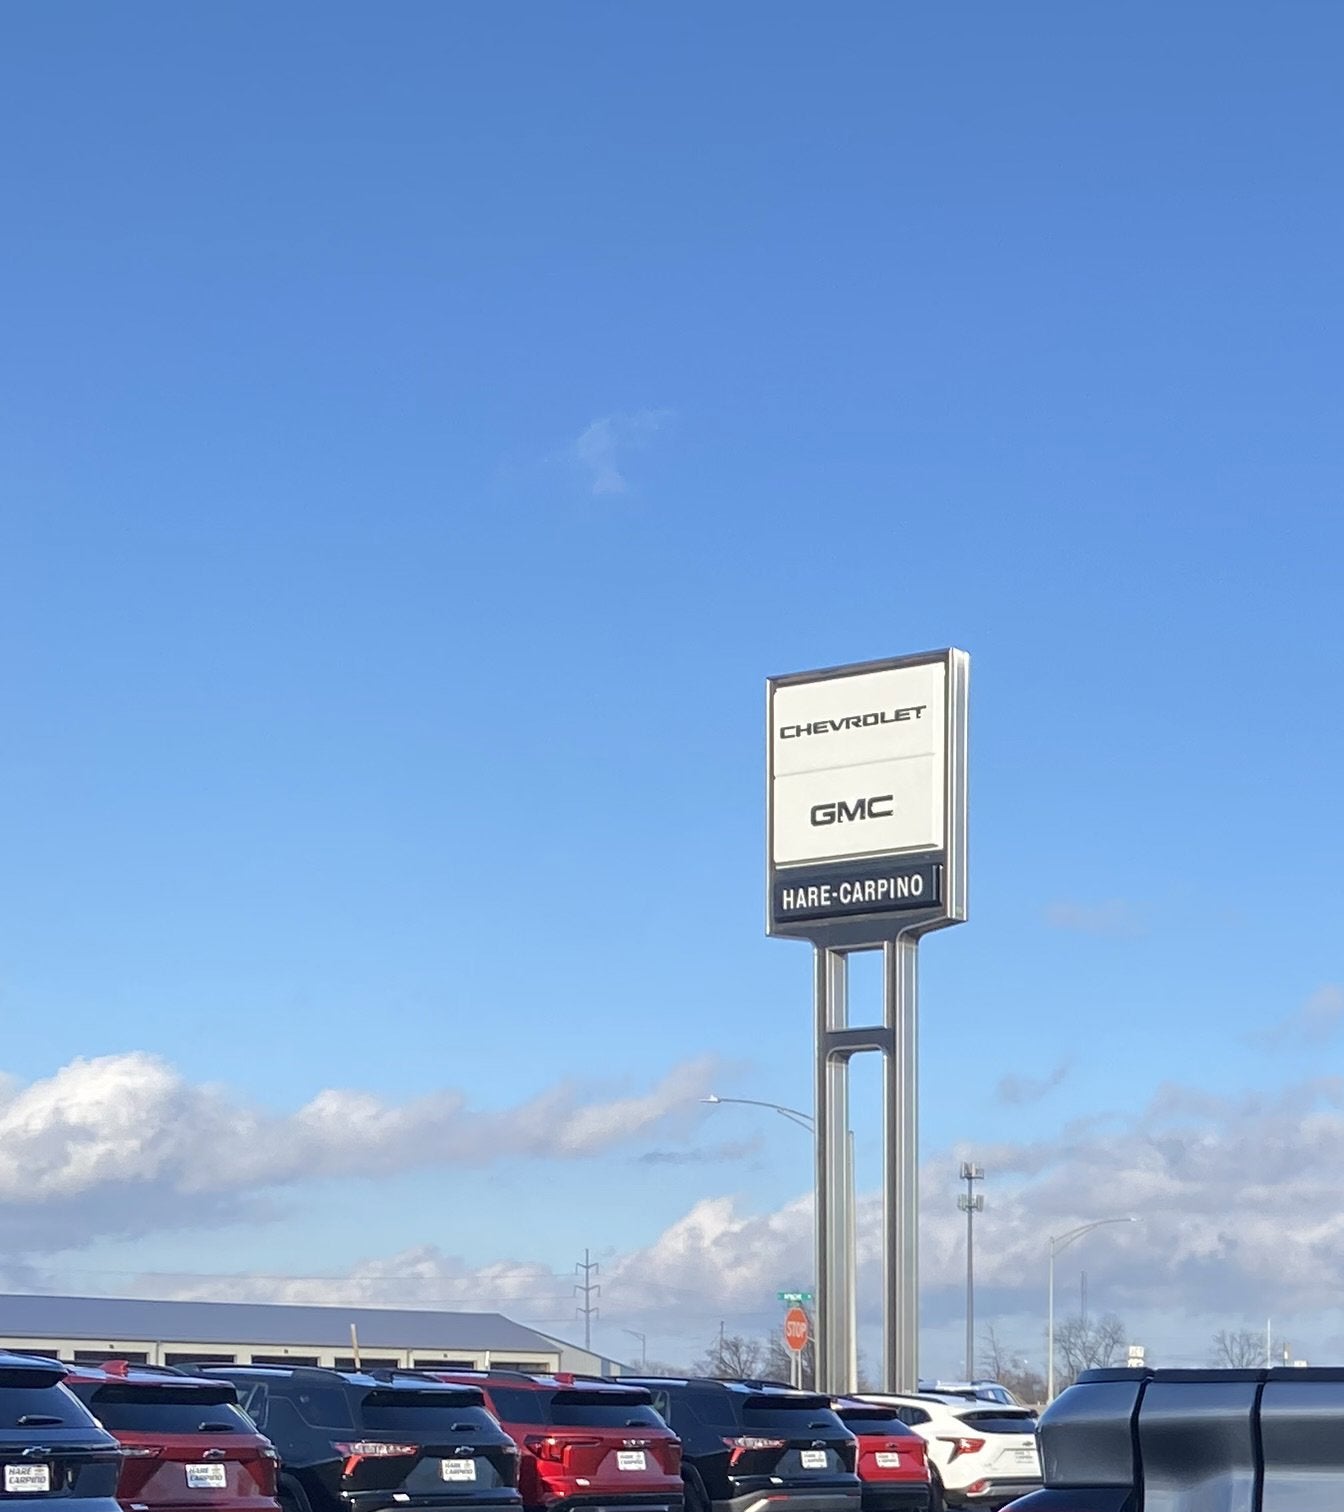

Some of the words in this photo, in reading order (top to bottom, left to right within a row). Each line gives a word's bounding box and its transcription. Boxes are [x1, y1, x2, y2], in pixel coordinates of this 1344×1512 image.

[780, 705, 927, 739] CHEVROLET
[810, 795, 893, 827] GMC
[782, 874, 924, 910] HARE-CARPINO
[786, 1321, 806, 1338] STOP
